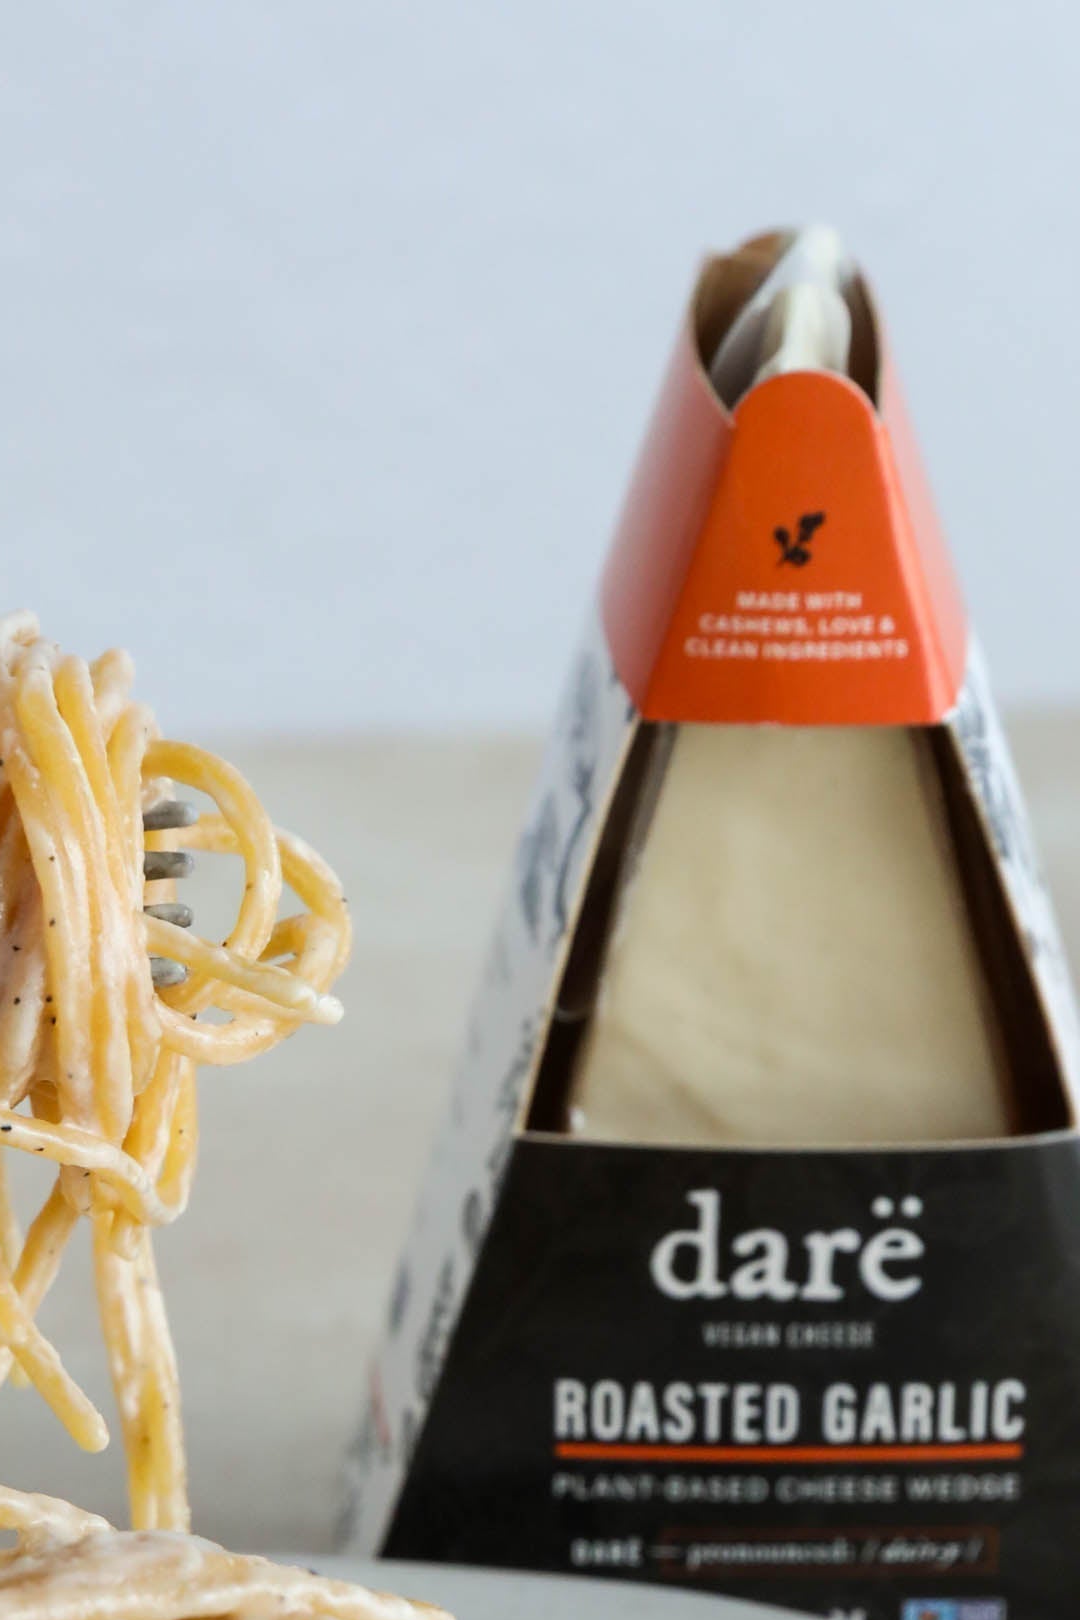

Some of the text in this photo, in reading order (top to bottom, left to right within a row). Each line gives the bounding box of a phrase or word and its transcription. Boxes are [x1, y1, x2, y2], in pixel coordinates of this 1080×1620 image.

[736, 591, 862, 610] MADE WITH
[819, 615, 874, 635] LOVE
[879, 615, 895, 634] &
[684, 638, 909, 660] CLEAN INGREDIENTS
[650, 1190, 924, 1300] darë
[703, 1322, 874, 1347] VEGAN CHEESE
[555, 1379, 1025, 1442] ROASTED GARLIC
[553, 1474, 1018, 1502] PLANT-BASED CHEESE WEDGE
